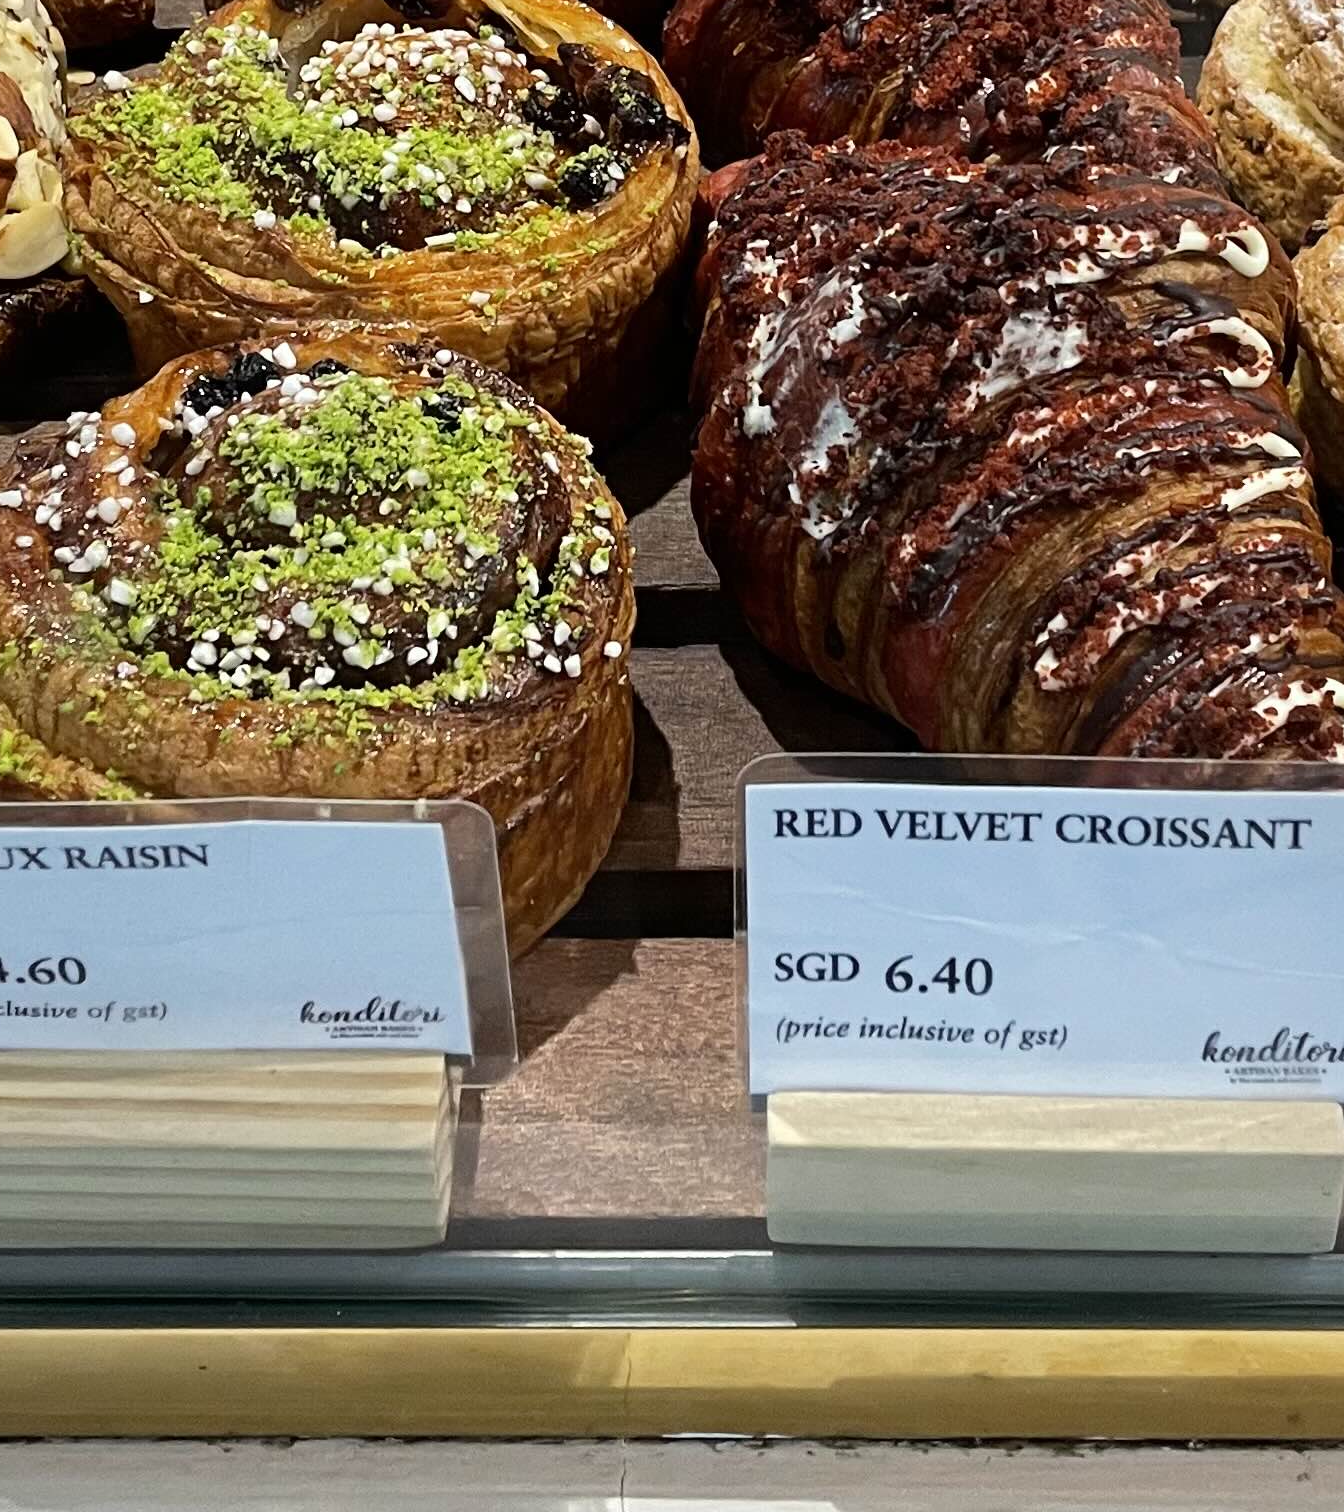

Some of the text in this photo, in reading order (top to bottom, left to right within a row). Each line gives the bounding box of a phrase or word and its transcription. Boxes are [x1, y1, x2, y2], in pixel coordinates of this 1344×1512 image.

[773, 808, 1314, 851] RED VELVET CROISSANT
[64, 843, 210, 870] RAISIN
[773, 951, 995, 997] SGD 6.40
[87, 999, 119, 1022] of
[121, 1001, 170, 1023] gst)
[299, 995, 446, 1025] konditori
[774, 1015, 1070, 1052] (price inclusive of gst)
